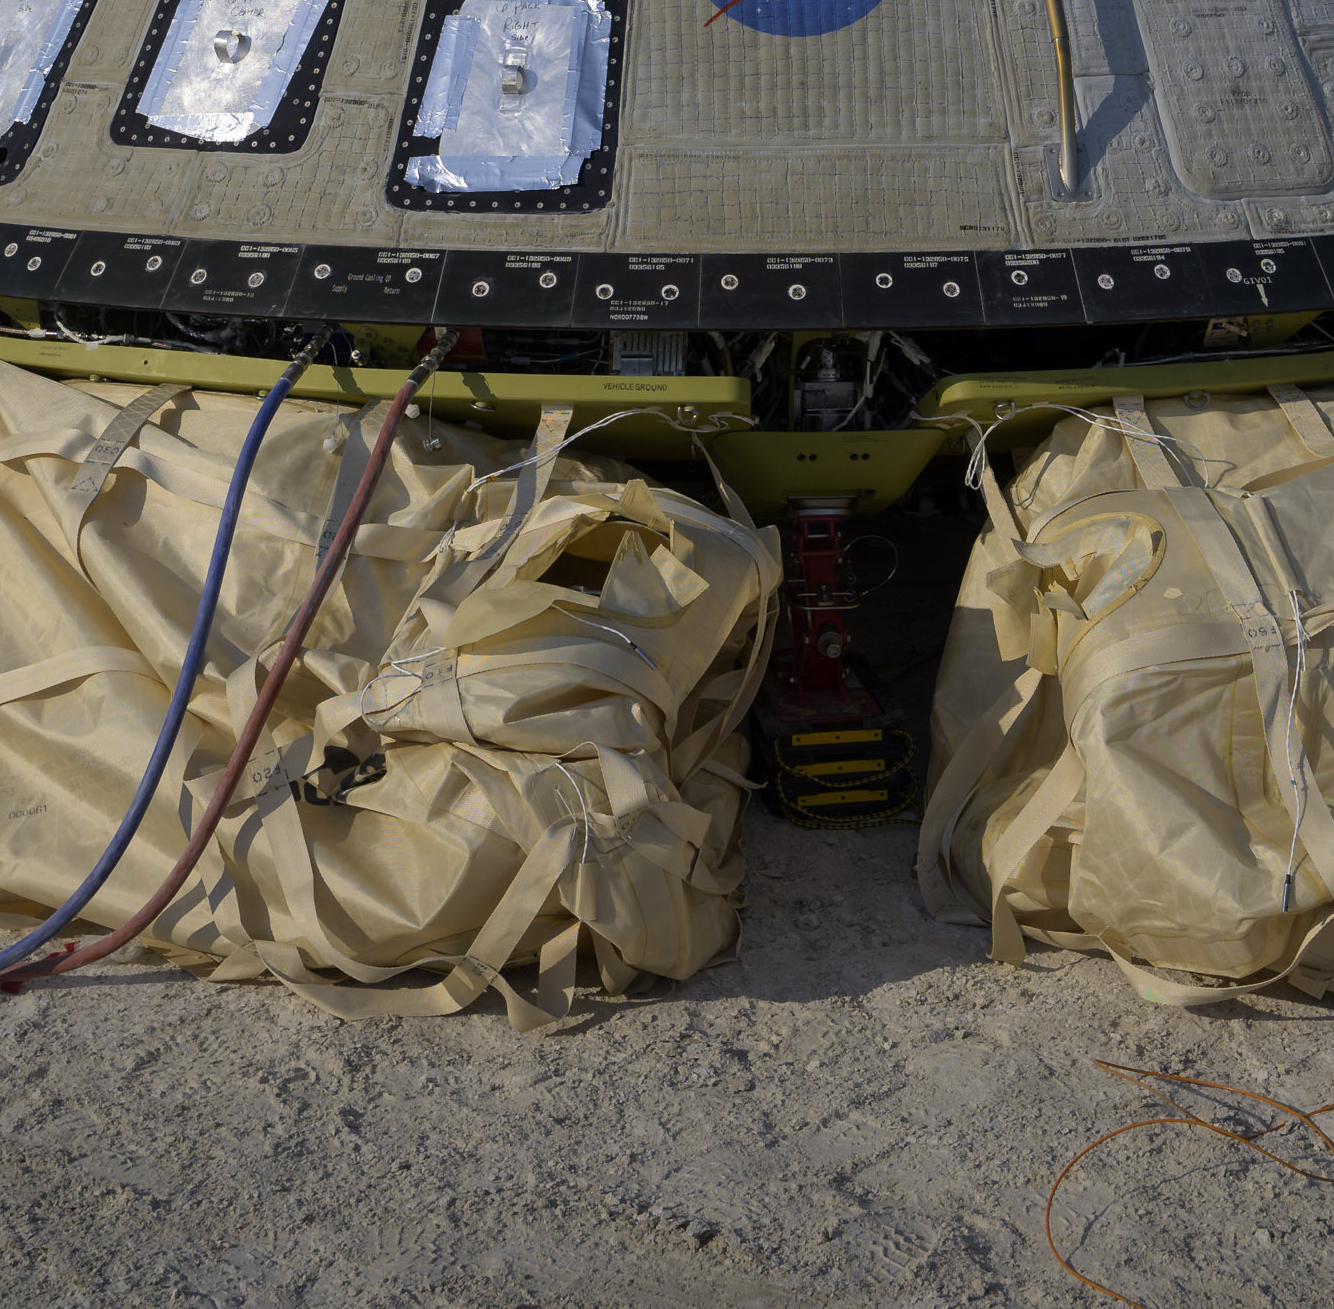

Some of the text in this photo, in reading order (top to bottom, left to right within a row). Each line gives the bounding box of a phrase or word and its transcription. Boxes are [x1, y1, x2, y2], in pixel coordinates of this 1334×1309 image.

[331, 284, 348, 294] Supply
[603, 383, 667, 392] VEHICLE GROUND
